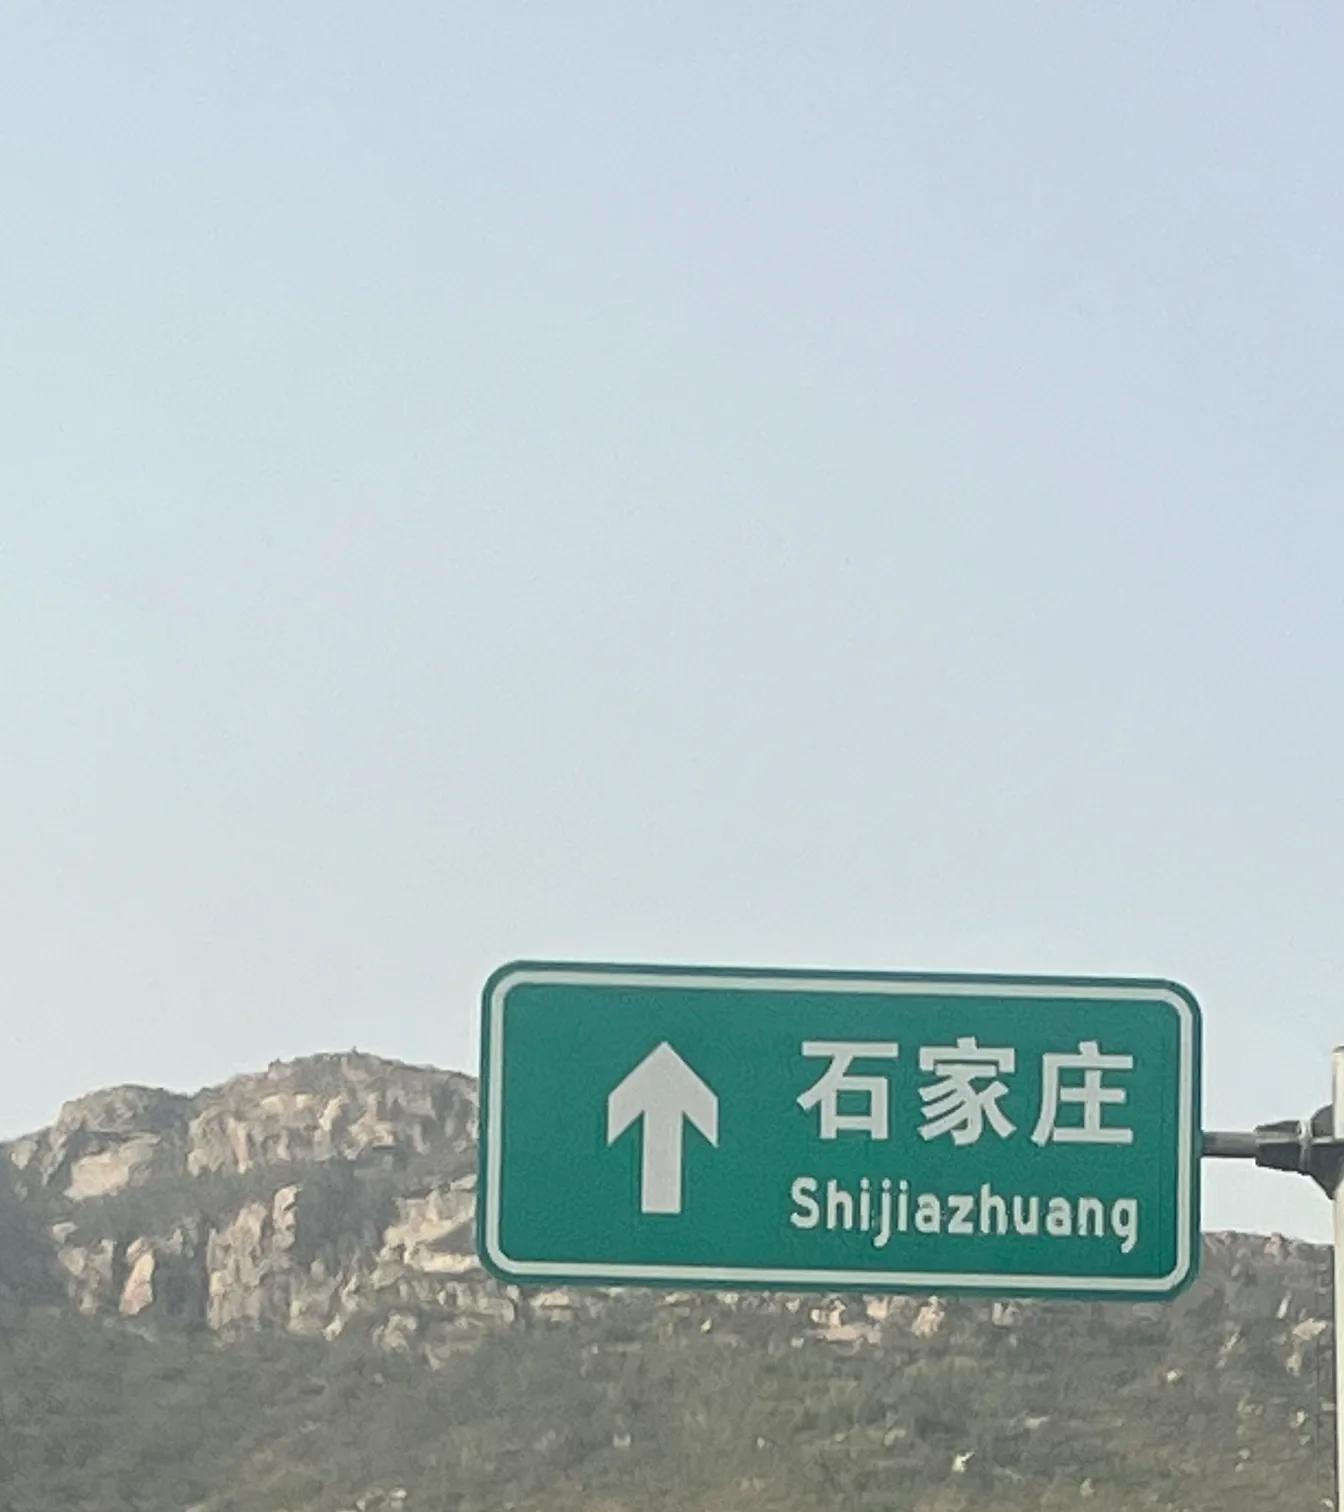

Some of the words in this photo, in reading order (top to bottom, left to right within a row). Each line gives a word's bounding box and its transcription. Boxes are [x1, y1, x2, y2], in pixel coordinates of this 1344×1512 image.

[797, 1036, 1133, 1146] 石家庄
[791, 1177, 1137, 1253] Shijiazhuang
